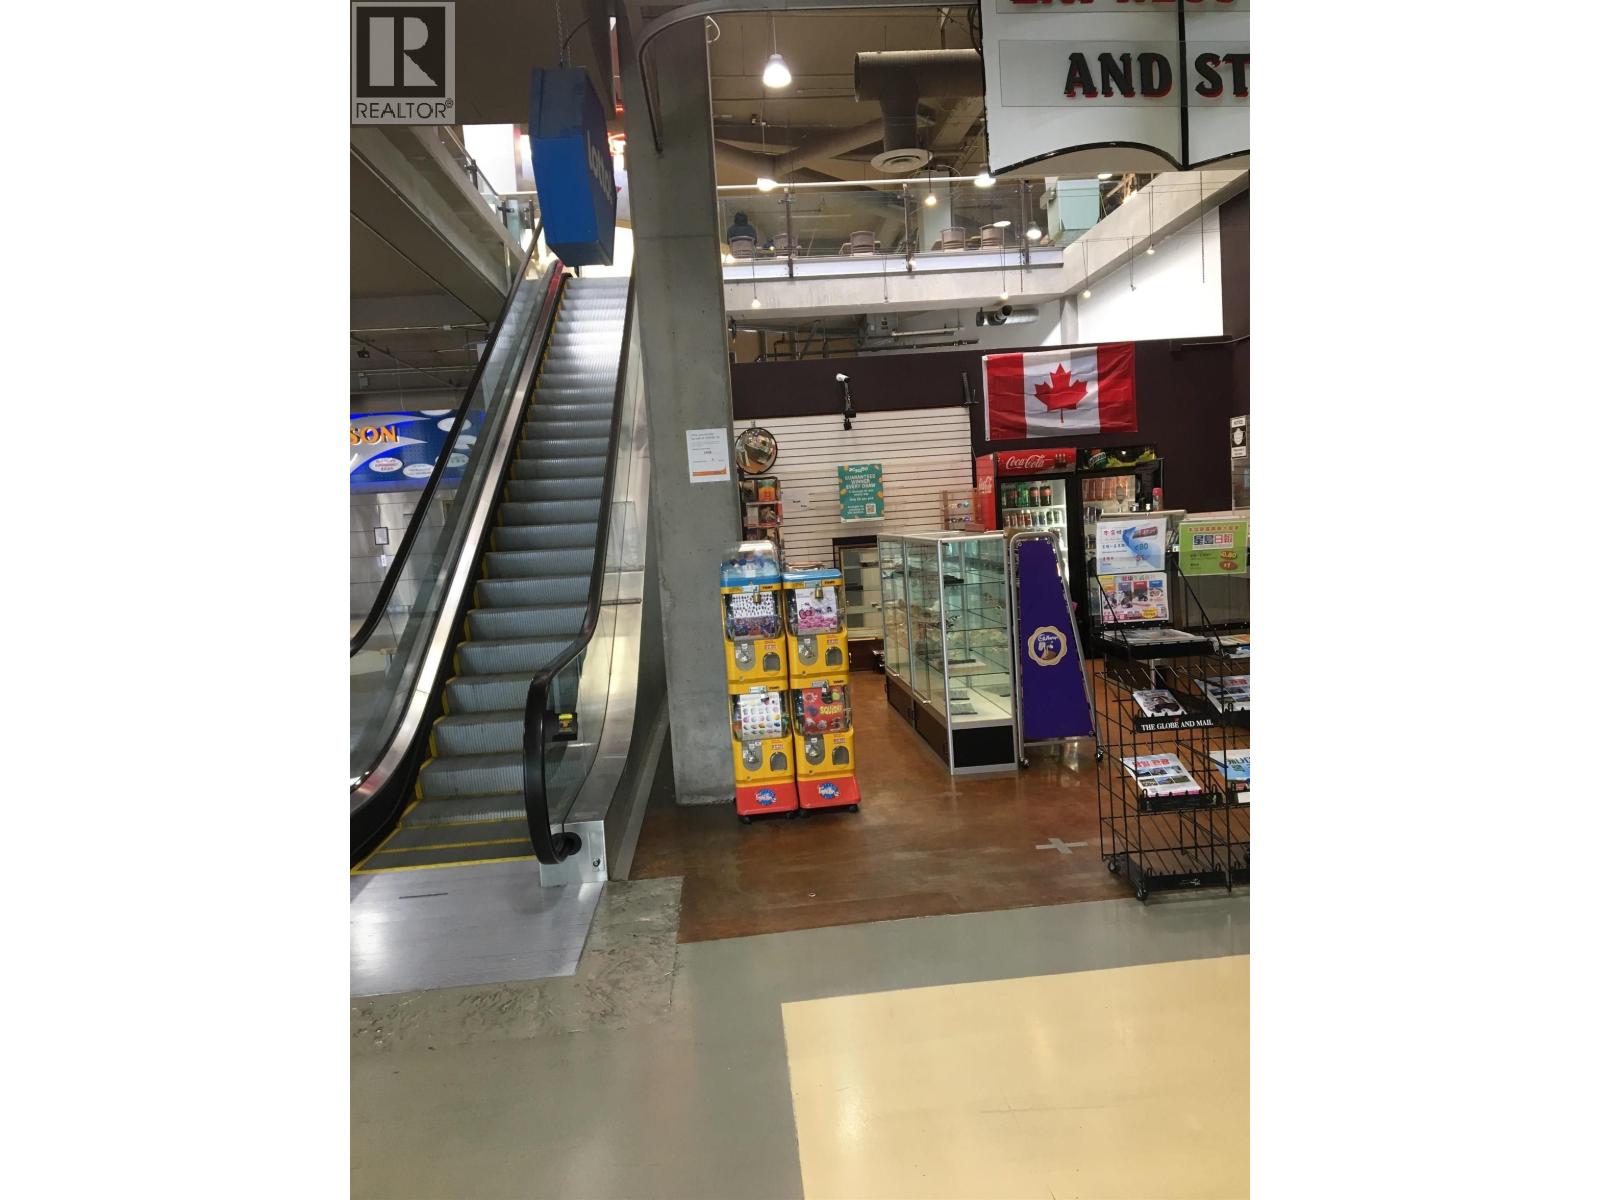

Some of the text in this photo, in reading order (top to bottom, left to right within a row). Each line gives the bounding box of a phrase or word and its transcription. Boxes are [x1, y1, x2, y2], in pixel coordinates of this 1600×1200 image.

[1064, 52, 1250, 99] AND ST
[350, 426, 400, 446] SON
[1141, 718, 1214, 732] THE GLOBE AND MAIL
